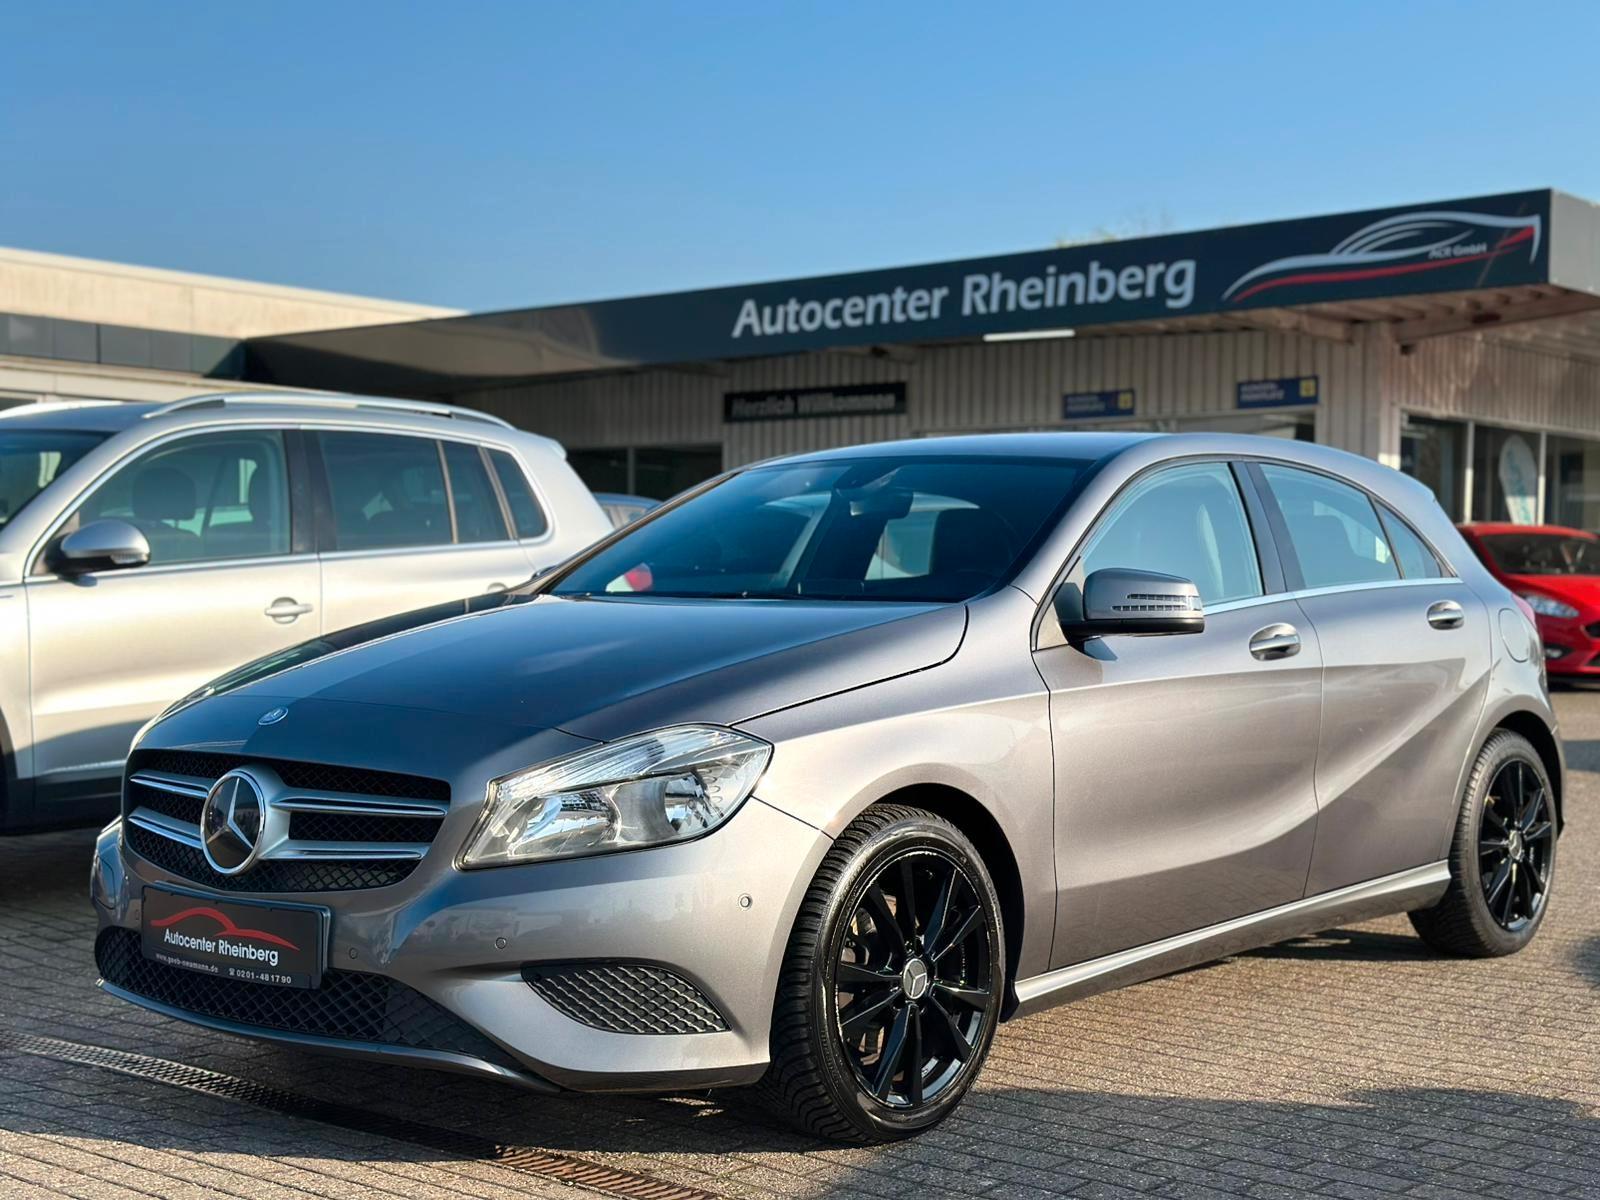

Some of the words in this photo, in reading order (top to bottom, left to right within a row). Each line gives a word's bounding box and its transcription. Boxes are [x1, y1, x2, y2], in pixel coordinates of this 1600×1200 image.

[1453, 243, 1487, 257] GmbH
[731, 284, 948, 338] Autocenter
[961, 259, 1197, 315] Rheinberg
[163, 928, 216, 953] Autocenter
[218, 939, 279, 967] Rheinberg
